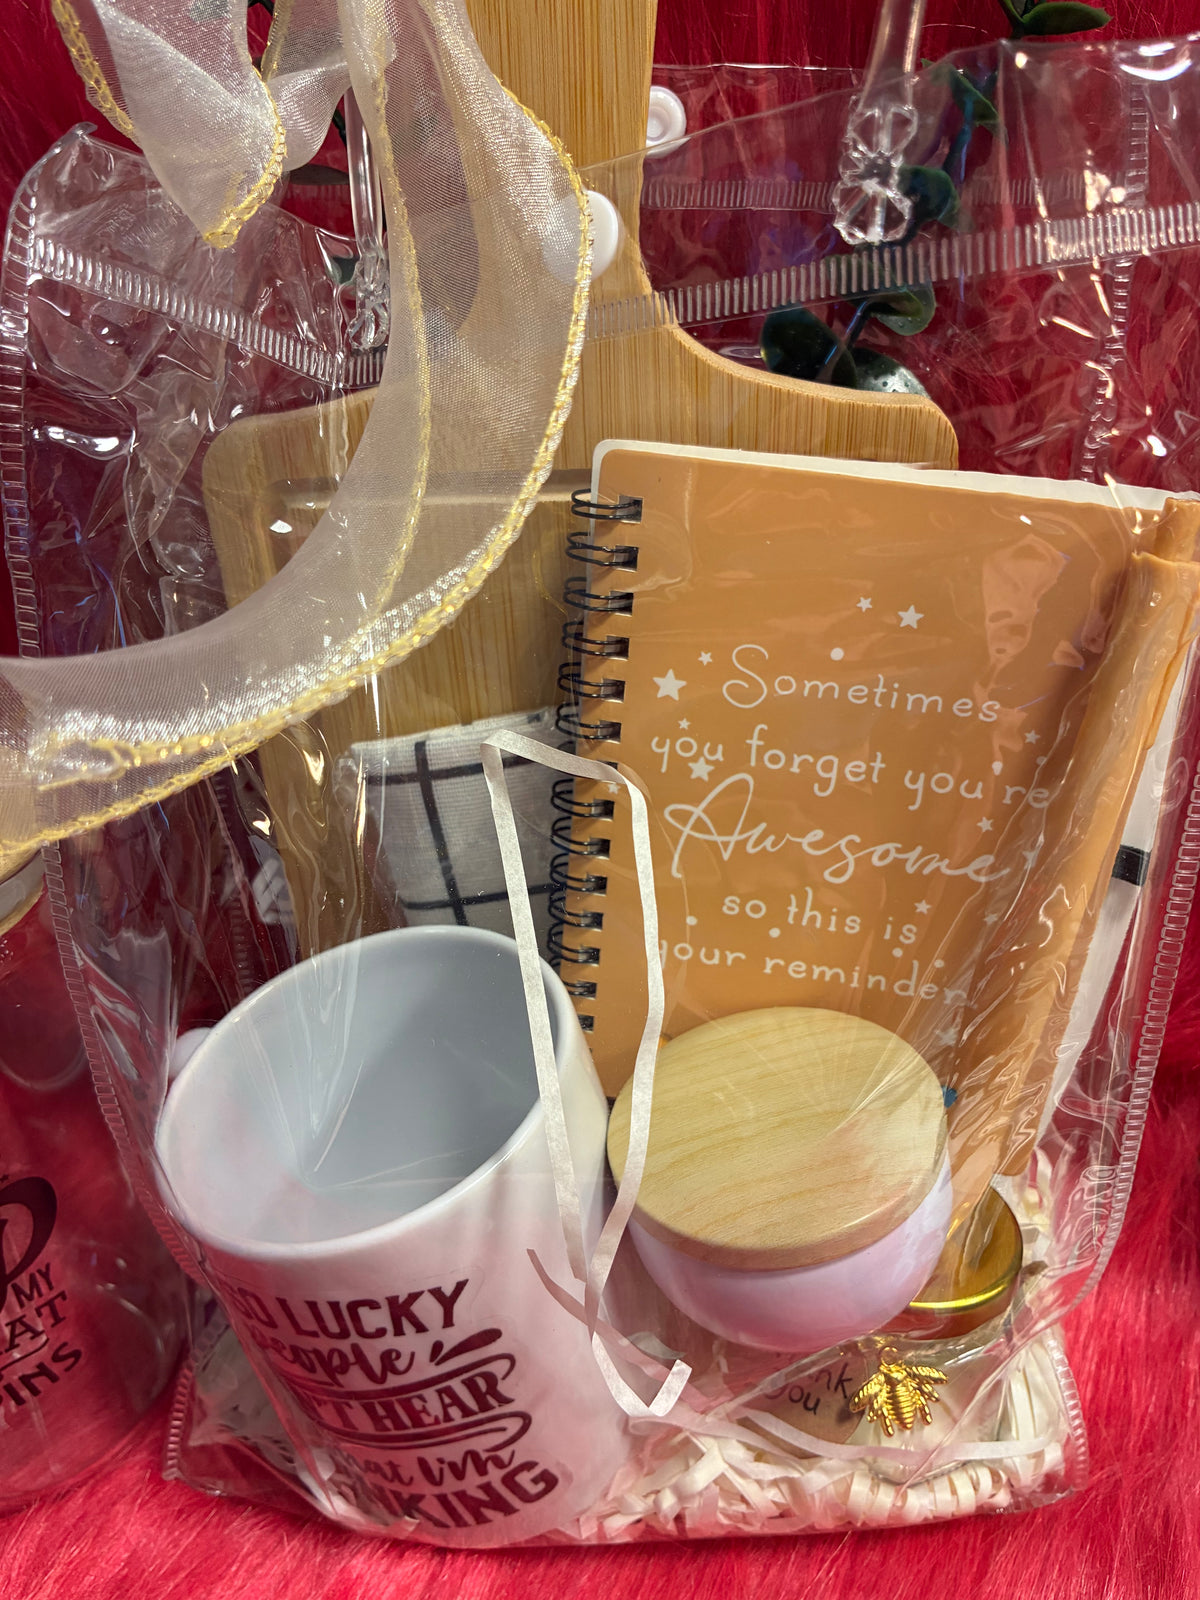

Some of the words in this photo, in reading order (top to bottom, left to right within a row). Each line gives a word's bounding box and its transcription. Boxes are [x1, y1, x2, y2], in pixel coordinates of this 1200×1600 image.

[722, 643, 1001, 722] Sometimes
[651, 735, 724, 773] you
[745, 724, 886, 797] forget
[904, 760, 1051, 811] you're
[664, 772, 1010, 884] Awesome
[721, 894, 767, 918] so
[787, 887, 861, 936] this
[884, 916, 917, 944] is
[11, 1262, 54, 1308] MY
[274, 1278, 470, 1340] LUCKY
[0, 1290, 68, 1352] AT
[0, 1341, 83, 1406] INS
[358, 1370, 516, 1433] HEAR
